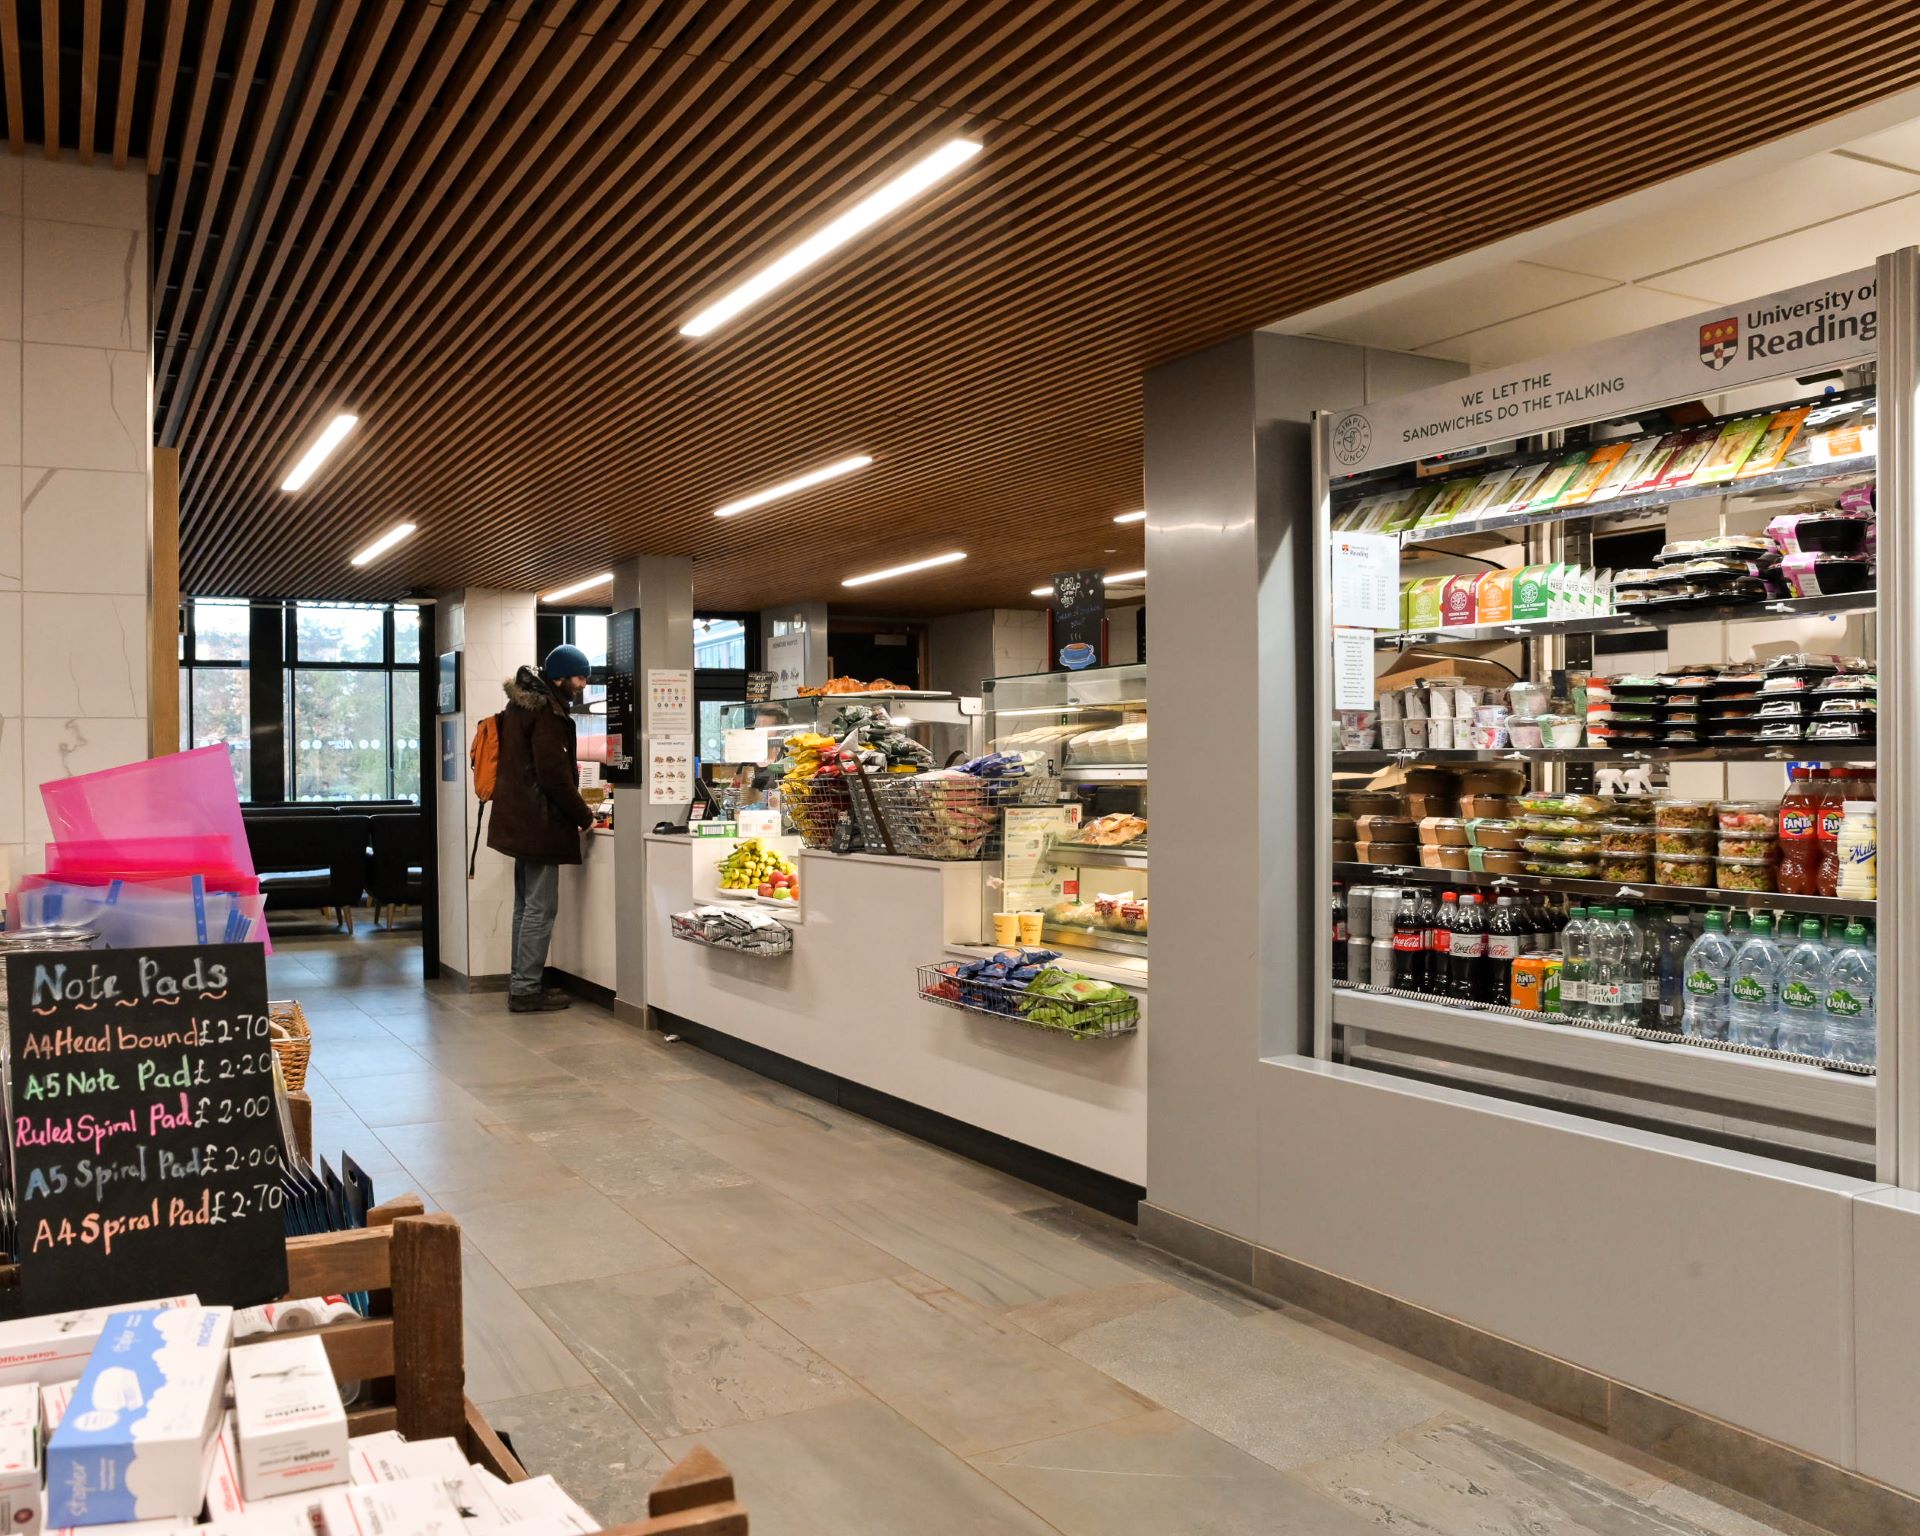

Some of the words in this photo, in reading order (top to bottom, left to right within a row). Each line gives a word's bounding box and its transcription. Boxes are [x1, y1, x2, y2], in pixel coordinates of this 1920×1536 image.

[1747, 290, 1854, 330] University
[1747, 311, 1877, 361] Reading
[1461, 391, 1485, 408] WE
[1492, 381, 1519, 400] LET
[1522, 373, 1553, 392] THE
[1338, 417, 1367, 436] SIMPLY
[1402, 409, 1494, 443] SANDWICHES
[1497, 403, 1519, 420] DO
[1522, 395, 1553, 413] THE
[1556, 377, 1626, 405] TALKING
[1338, 444, 1367, 462] LUNCH
[1783, 817, 1812, 830] FANTA
[1823, 818, 1841, 831] FAN
[32, 962, 122, 1006] Note
[139, 956, 229, 998] Pads
[1687, 978, 1716, 991] Volvic
[1733, 984, 1763, 997] Volvic
[1783, 989, 1814, 1003] Volvic
[1826, 998, 1858, 1011] Volvic
[23, 1032, 53, 1060] A4
[54, 1024, 112, 1057] Head
[117, 1017, 200, 1050] bound
[24, 1067, 60, 1101] A5
[66, 1066, 121, 1096] Note
[136, 1054, 192, 1092] Pad
[14, 1114, 75, 1148] Ruled
[76, 1110, 138, 1155] Spiral
[149, 1092, 193, 1137] Pad
[23, 1162, 68, 1202] A5
[73, 1144, 148, 1202] Spiral
[157, 1147, 201, 1181] Pad
[31, 1214, 77, 1253] A4
[80, 1196, 160, 1256] Spiral
[167, 1187, 210, 1227] Pad
